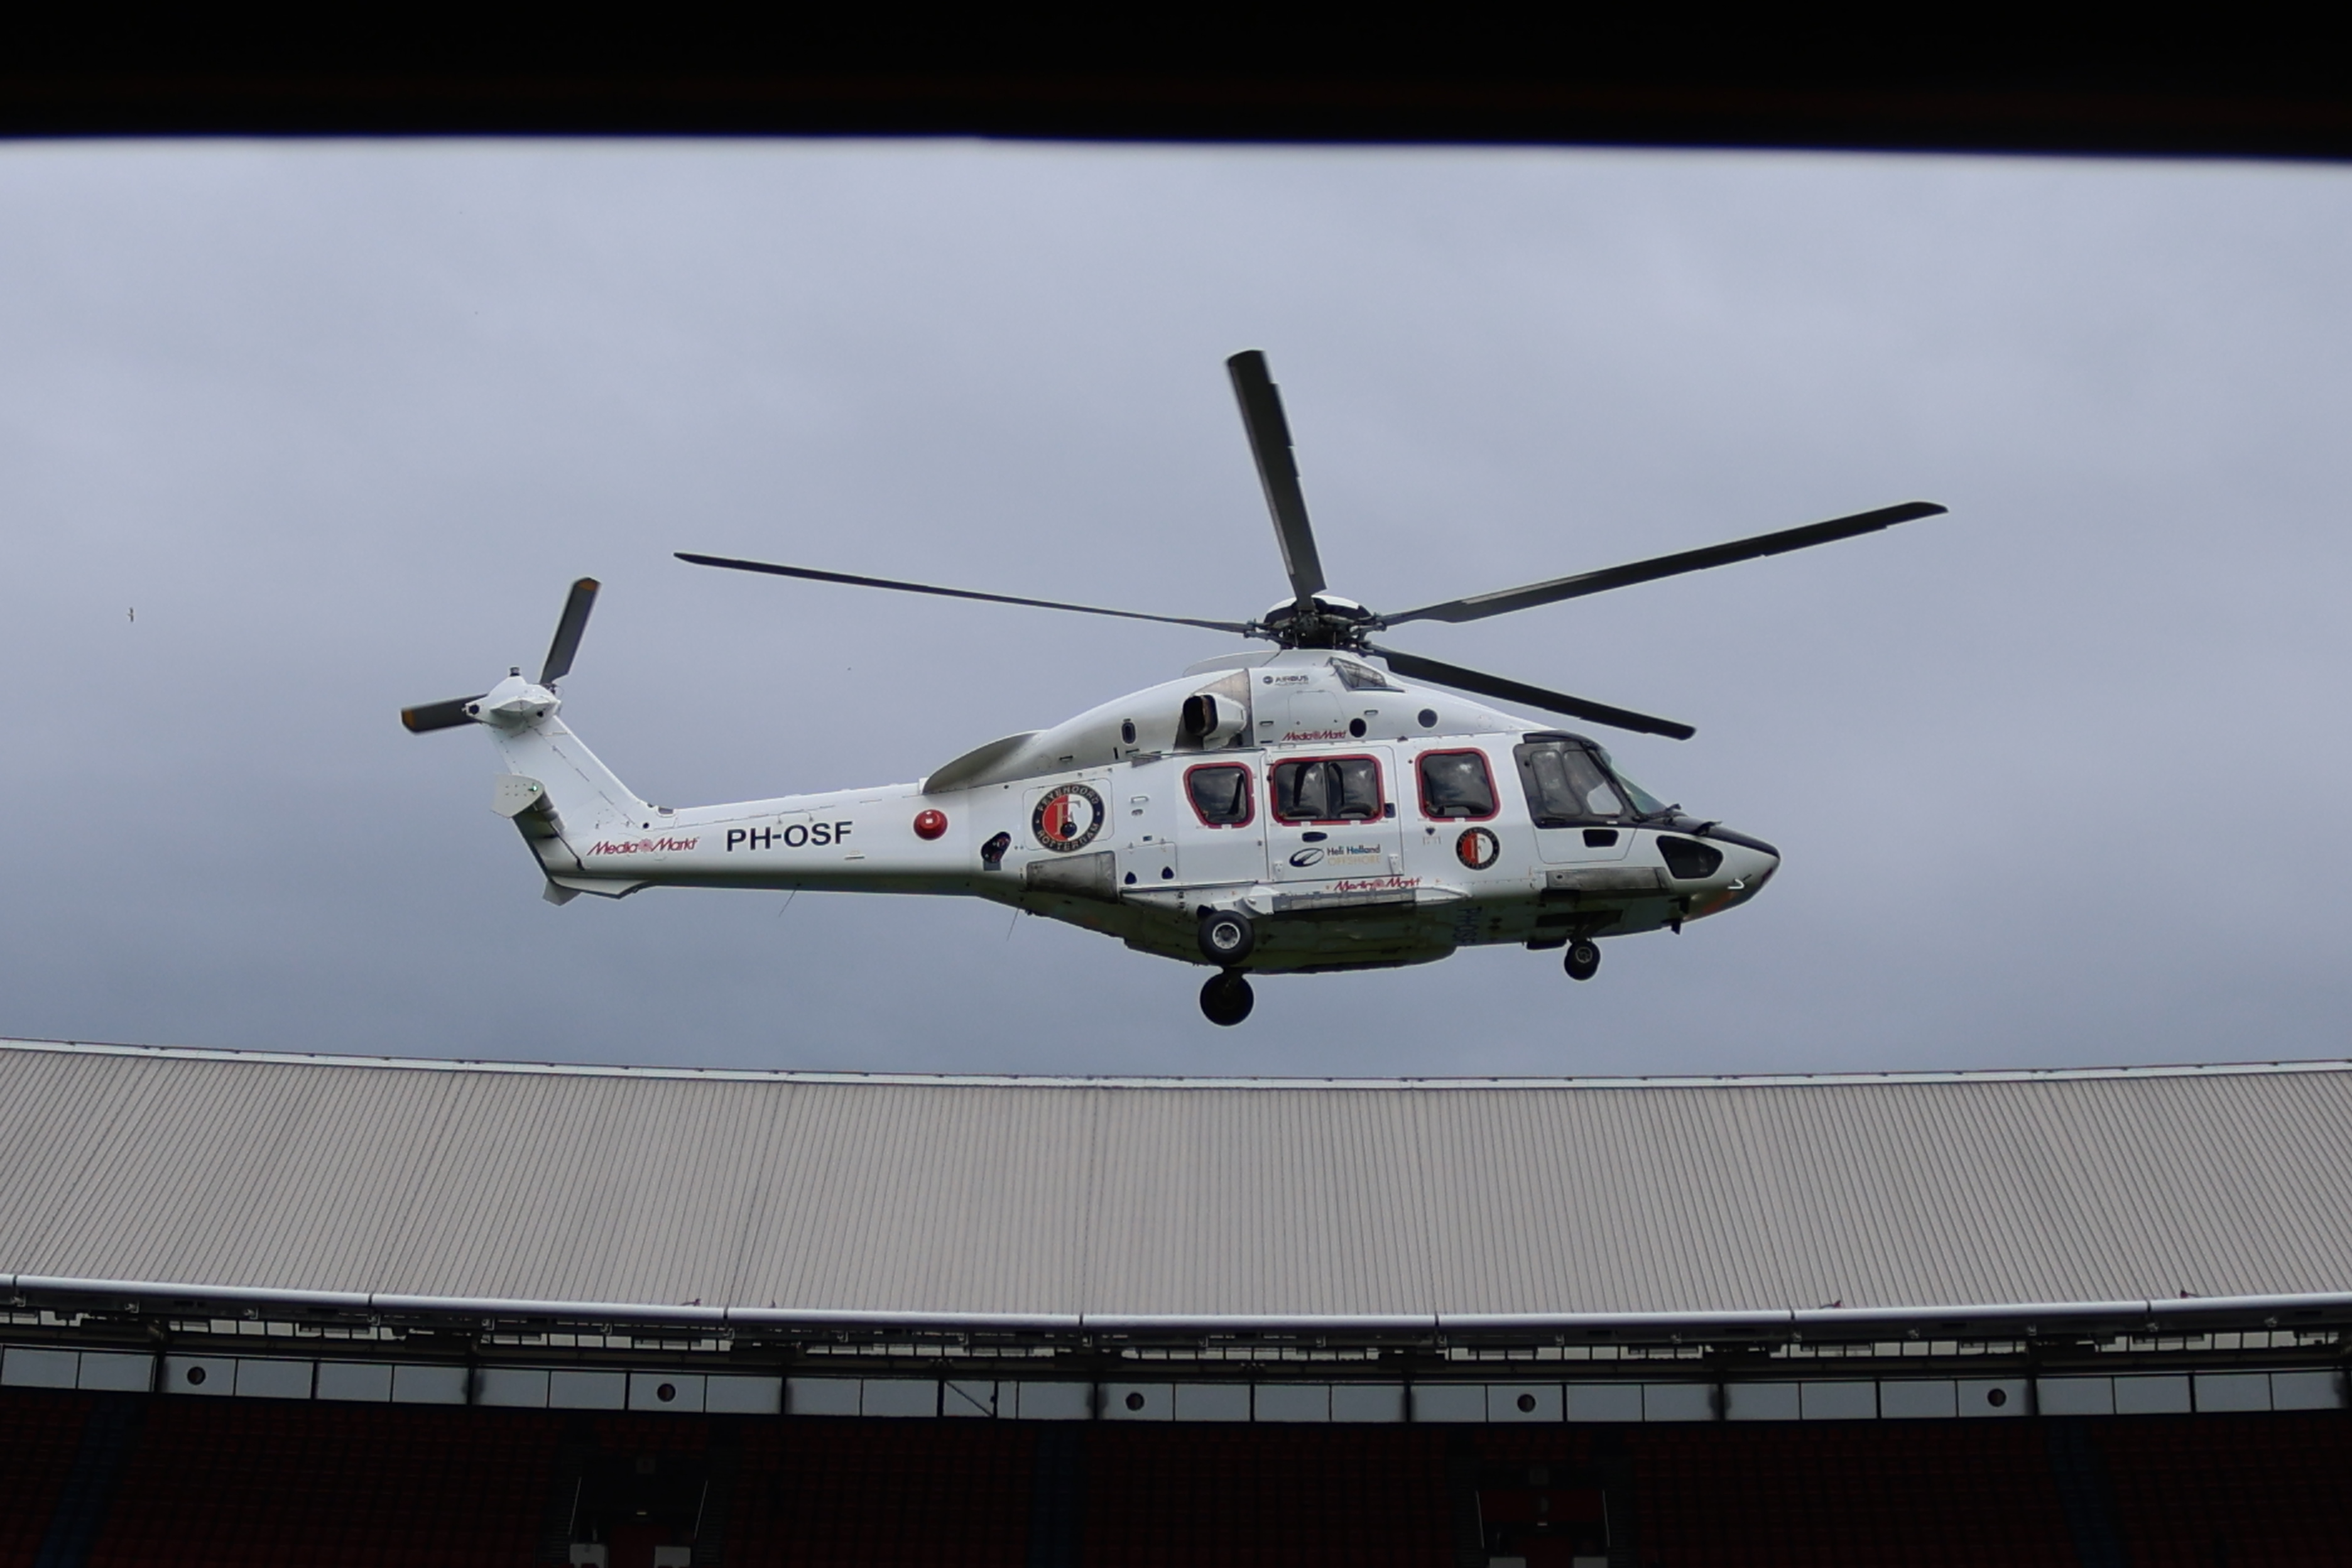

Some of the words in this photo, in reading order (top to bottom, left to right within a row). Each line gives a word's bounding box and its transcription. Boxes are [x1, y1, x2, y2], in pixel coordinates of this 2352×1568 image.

[1275, 675, 1309, 683] AIRBUS
[1282, 732, 1312, 741] Media
[1319, 730, 1346, 739] Markt
[1037, 786, 1099, 811] FEYENOORD
[726, 821, 853, 852] PH-OSF
[1037, 823, 1099, 851] ROTTERDAM
[587, 841, 638, 856] Media
[651, 837, 698, 852] Markt
[1327, 846, 1344, 856] Heli
[1347, 844, 1380, 854] Holland
